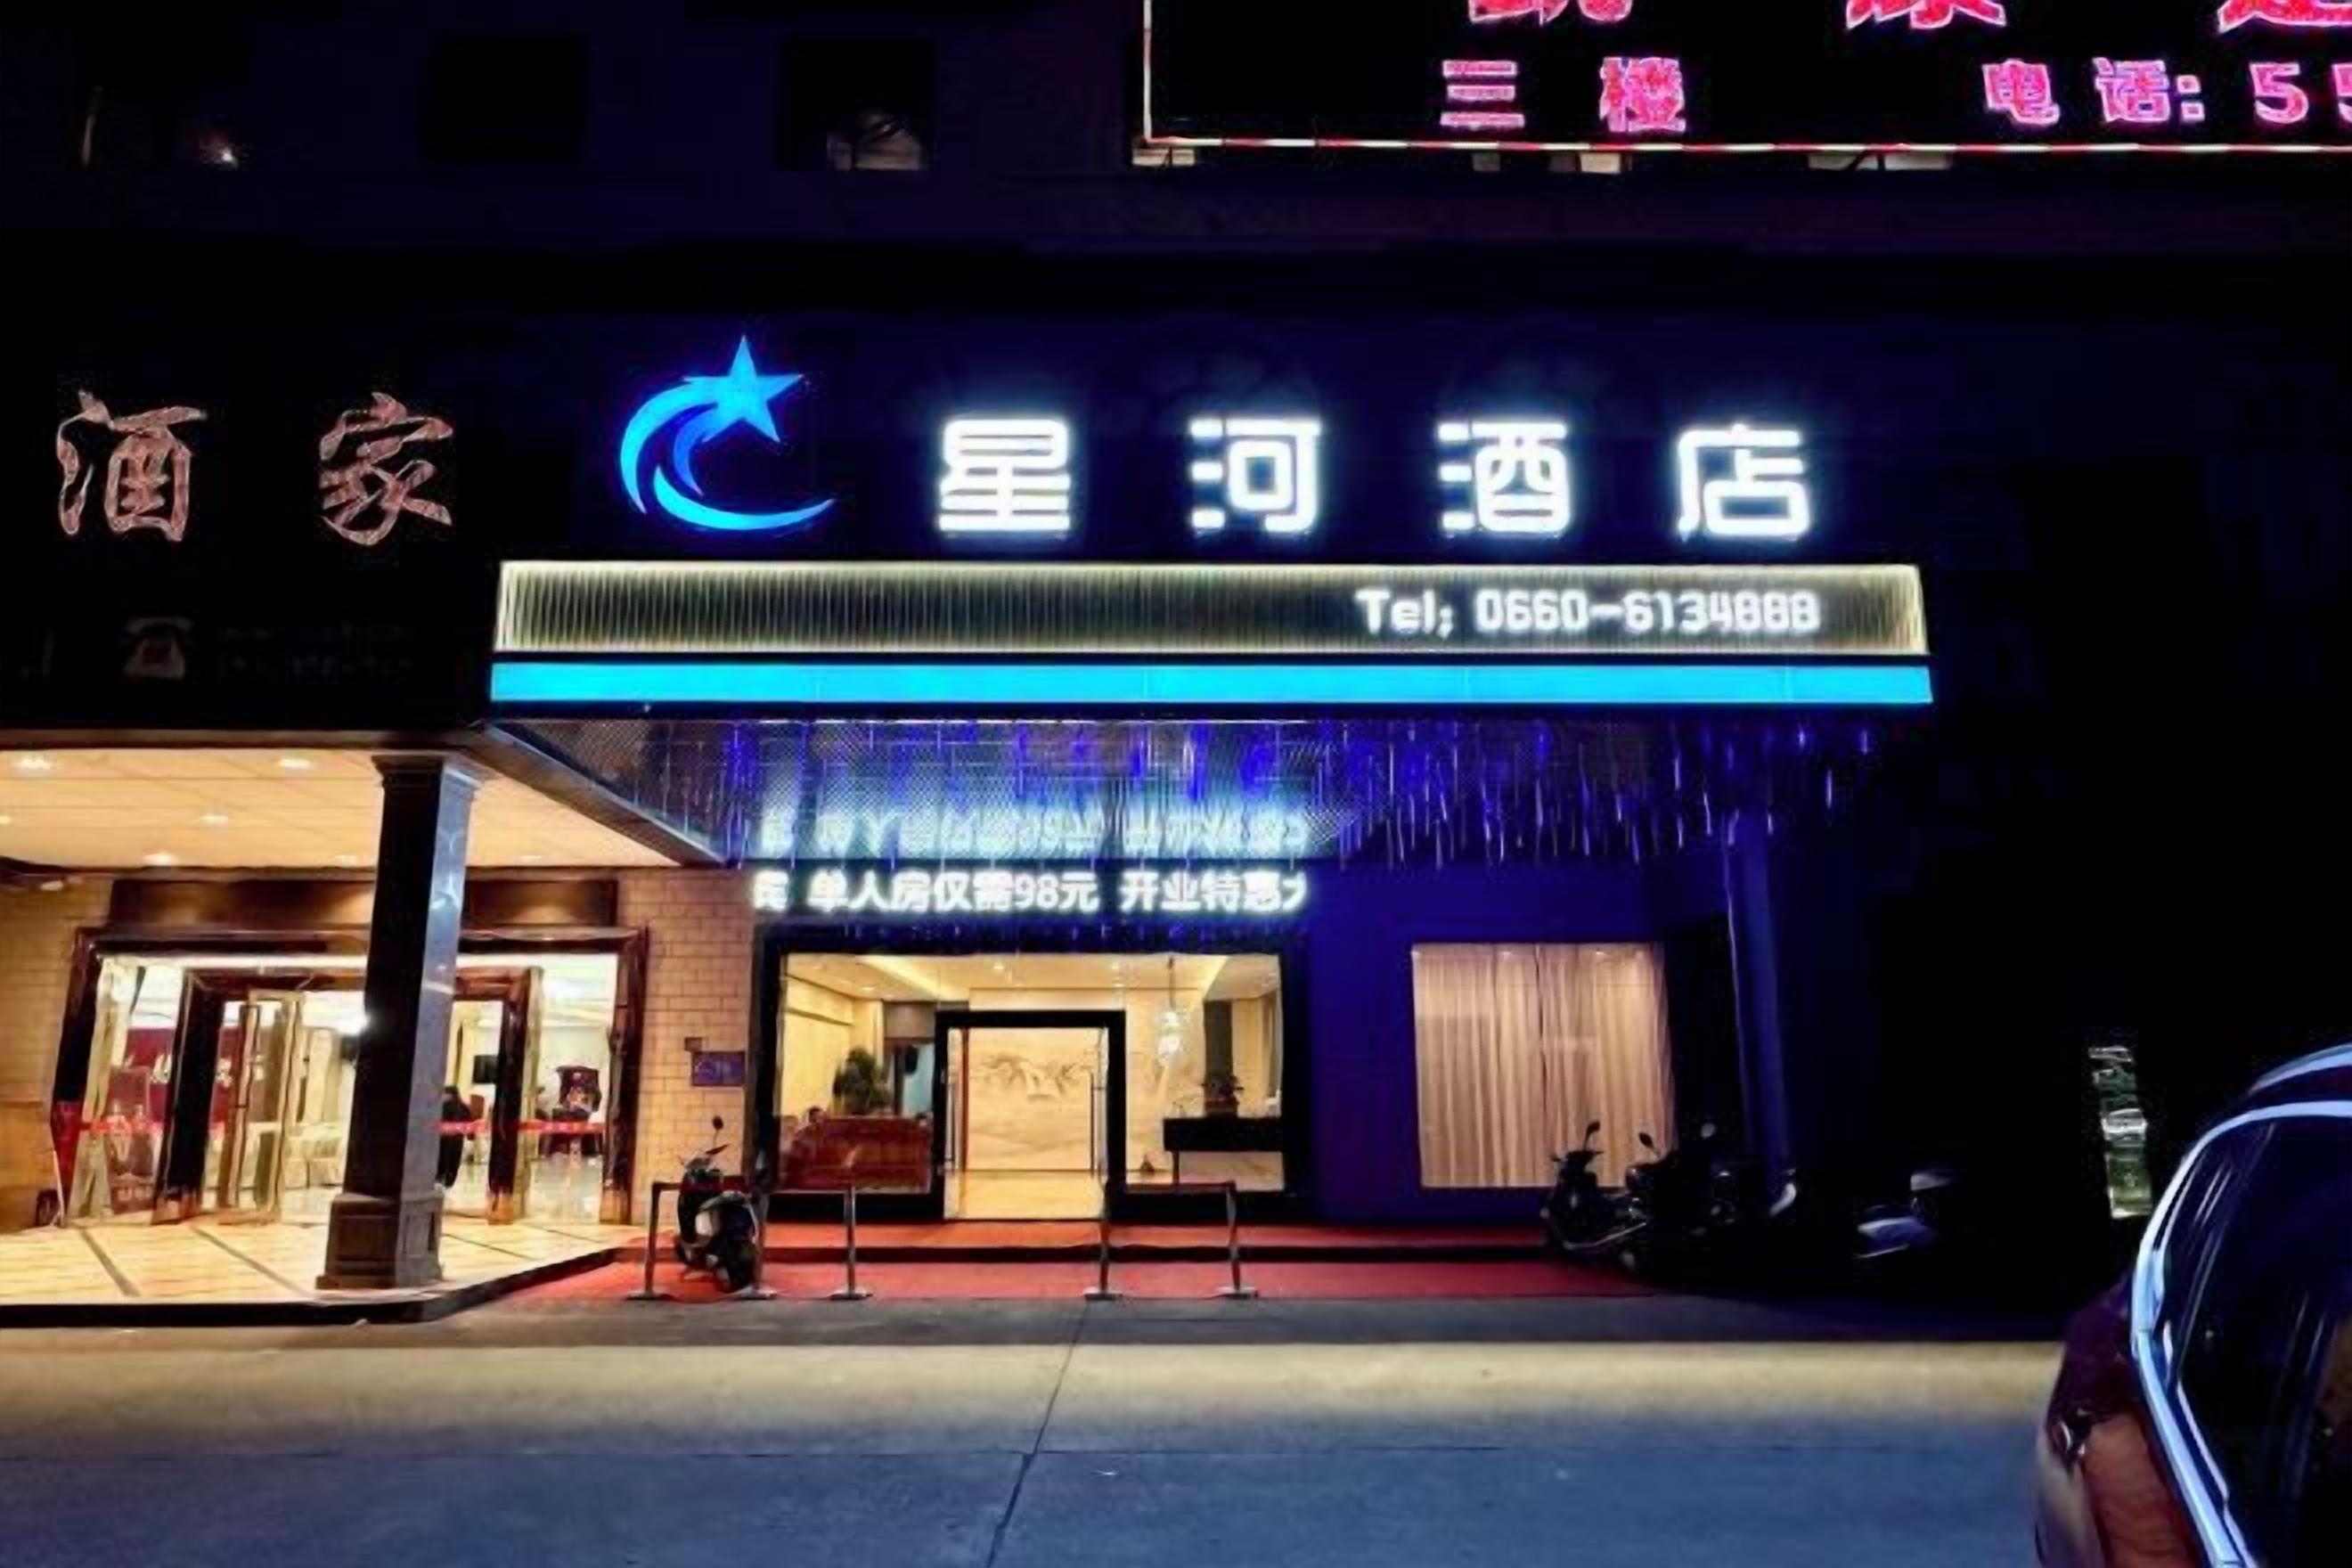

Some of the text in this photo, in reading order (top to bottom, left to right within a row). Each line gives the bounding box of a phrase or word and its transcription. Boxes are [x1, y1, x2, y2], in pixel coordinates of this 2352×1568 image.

[56, 389, 454, 546] 酒家
[937, 415, 1812, 542] 星河酒店
[807, 868, 1100, 913] 单人房仅需98元
